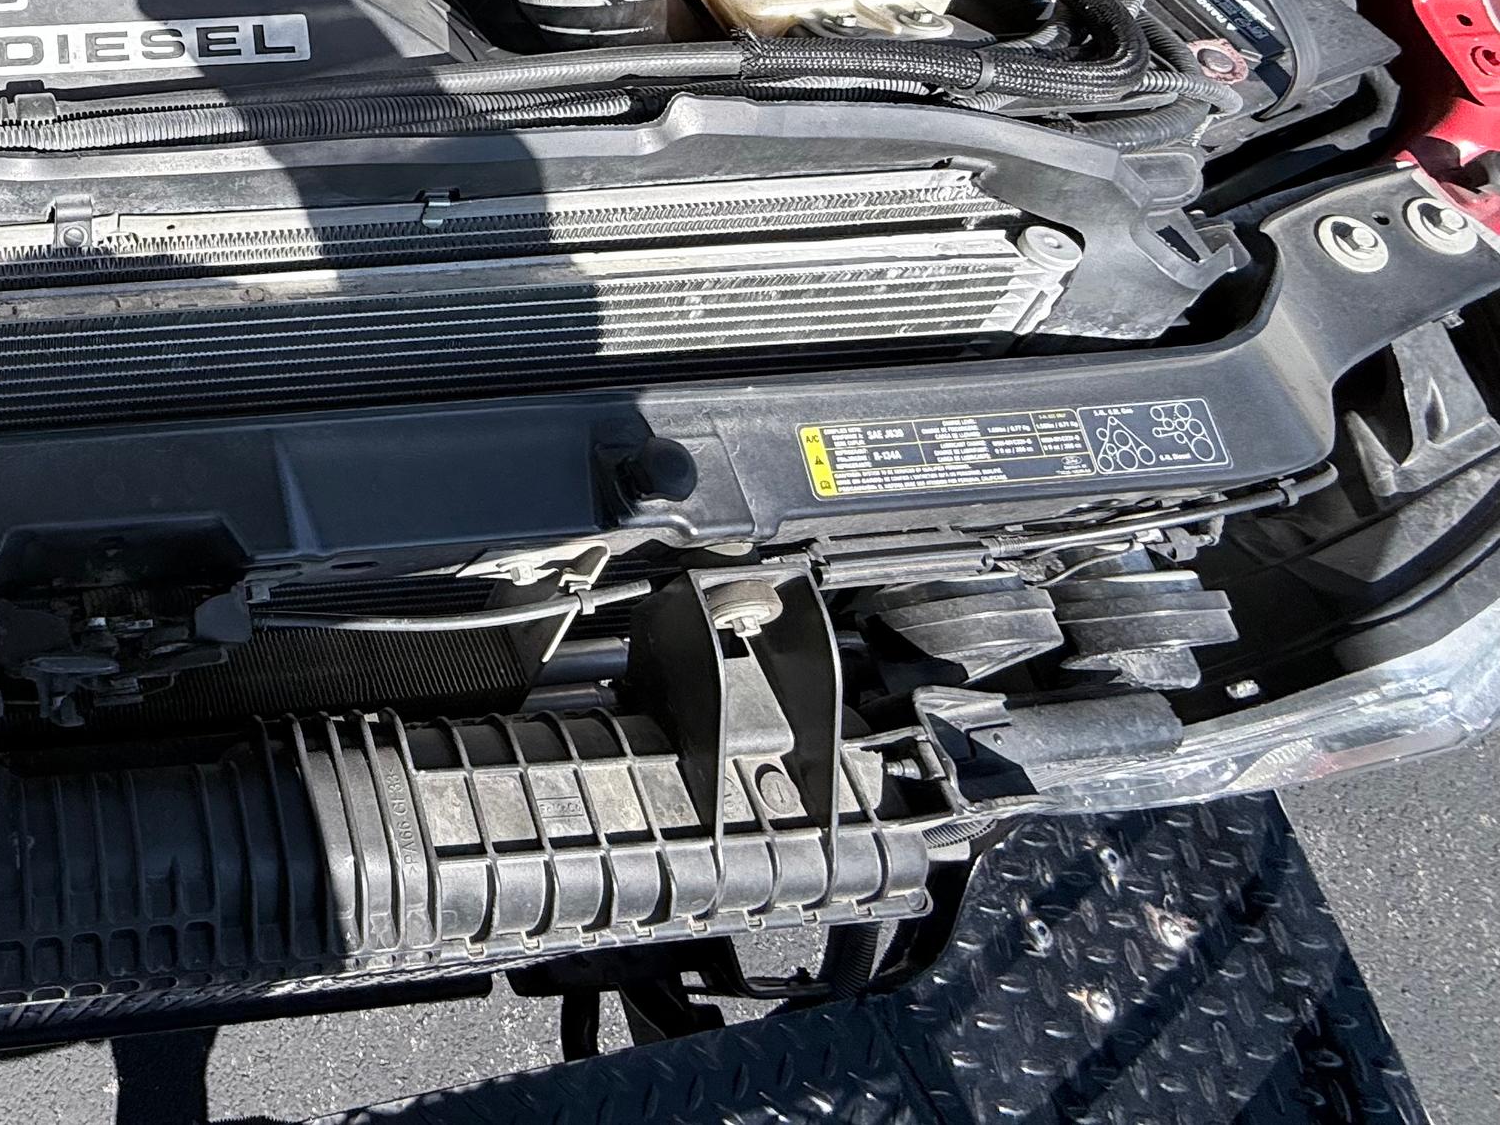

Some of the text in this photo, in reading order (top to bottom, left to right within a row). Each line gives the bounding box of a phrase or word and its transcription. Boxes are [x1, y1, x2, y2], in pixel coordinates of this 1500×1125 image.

[805, 435, 819, 443] A/C
[866, 430, 883, 440] SAE
[872, 450, 901, 461] R-134A
